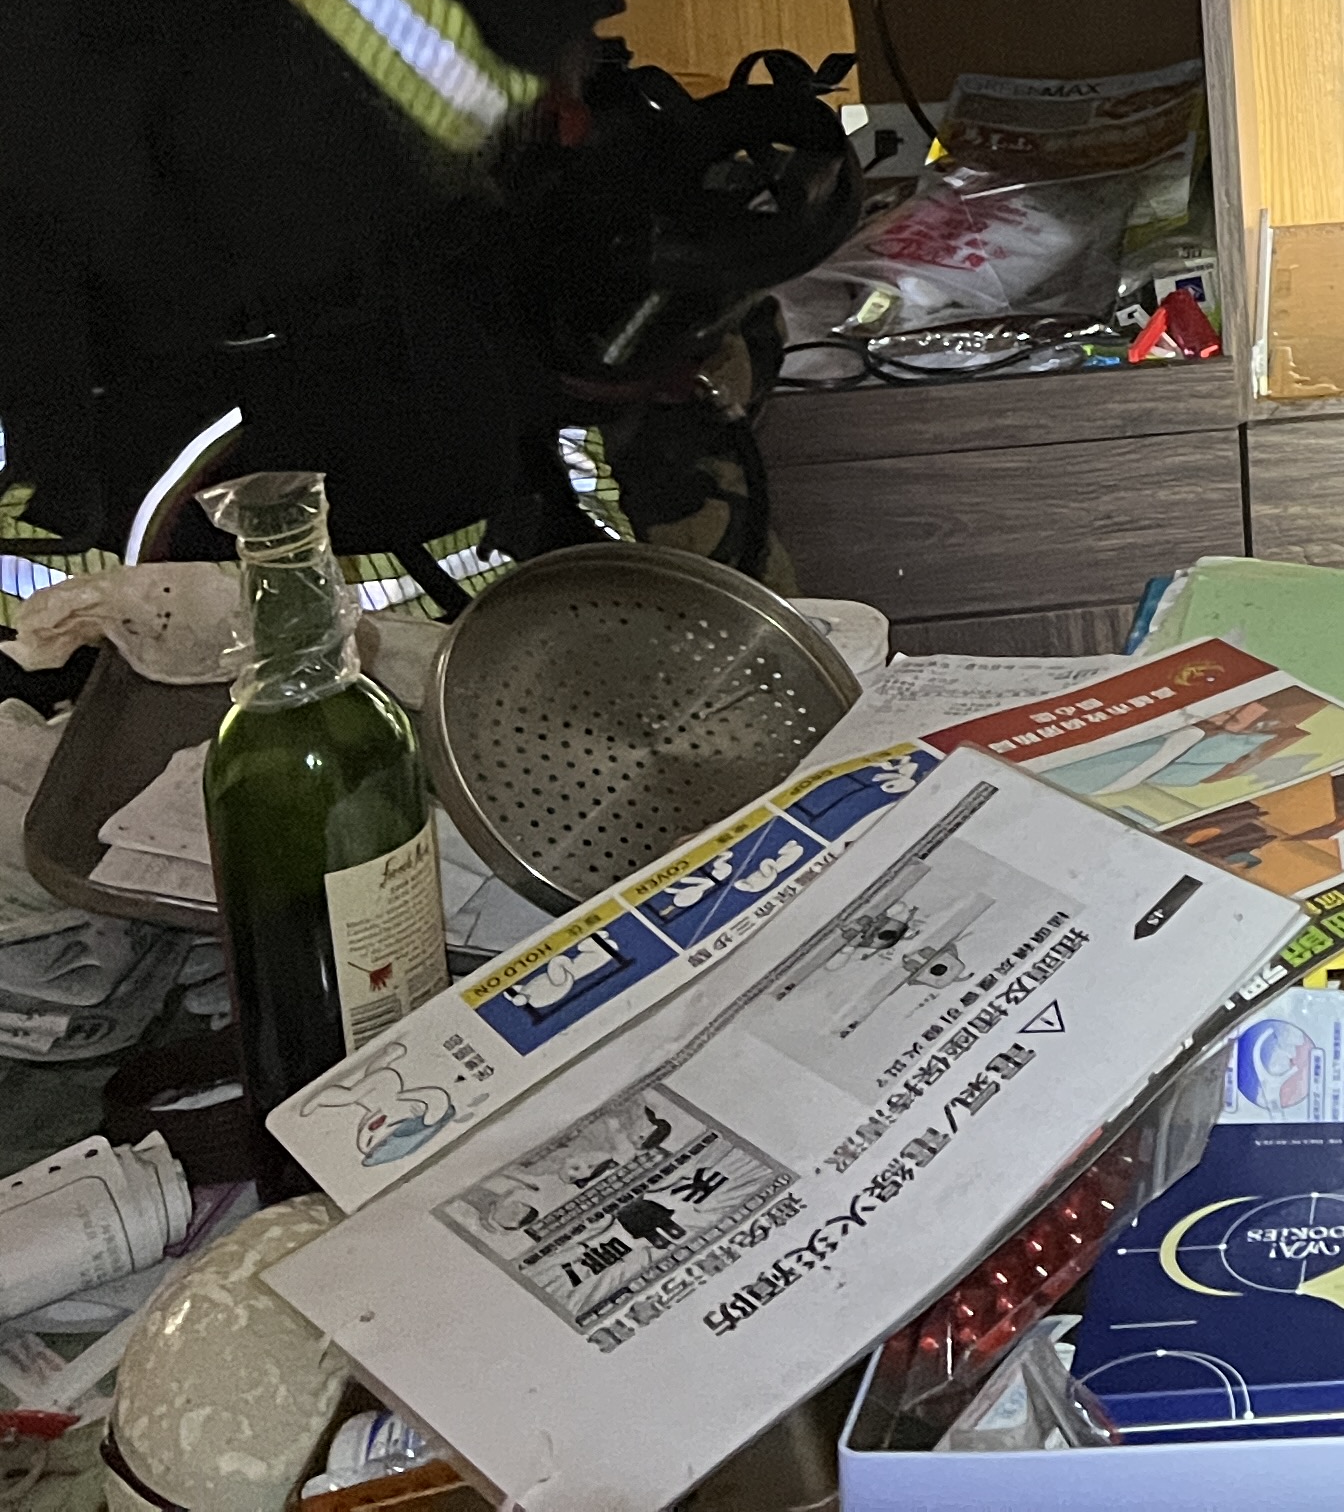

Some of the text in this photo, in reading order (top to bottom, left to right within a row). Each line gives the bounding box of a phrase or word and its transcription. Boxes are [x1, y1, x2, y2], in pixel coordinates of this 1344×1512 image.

[634, 856, 690, 897] COVER
[501, 942, 553, 980] HOLD
[471, 974, 502, 998] ON
